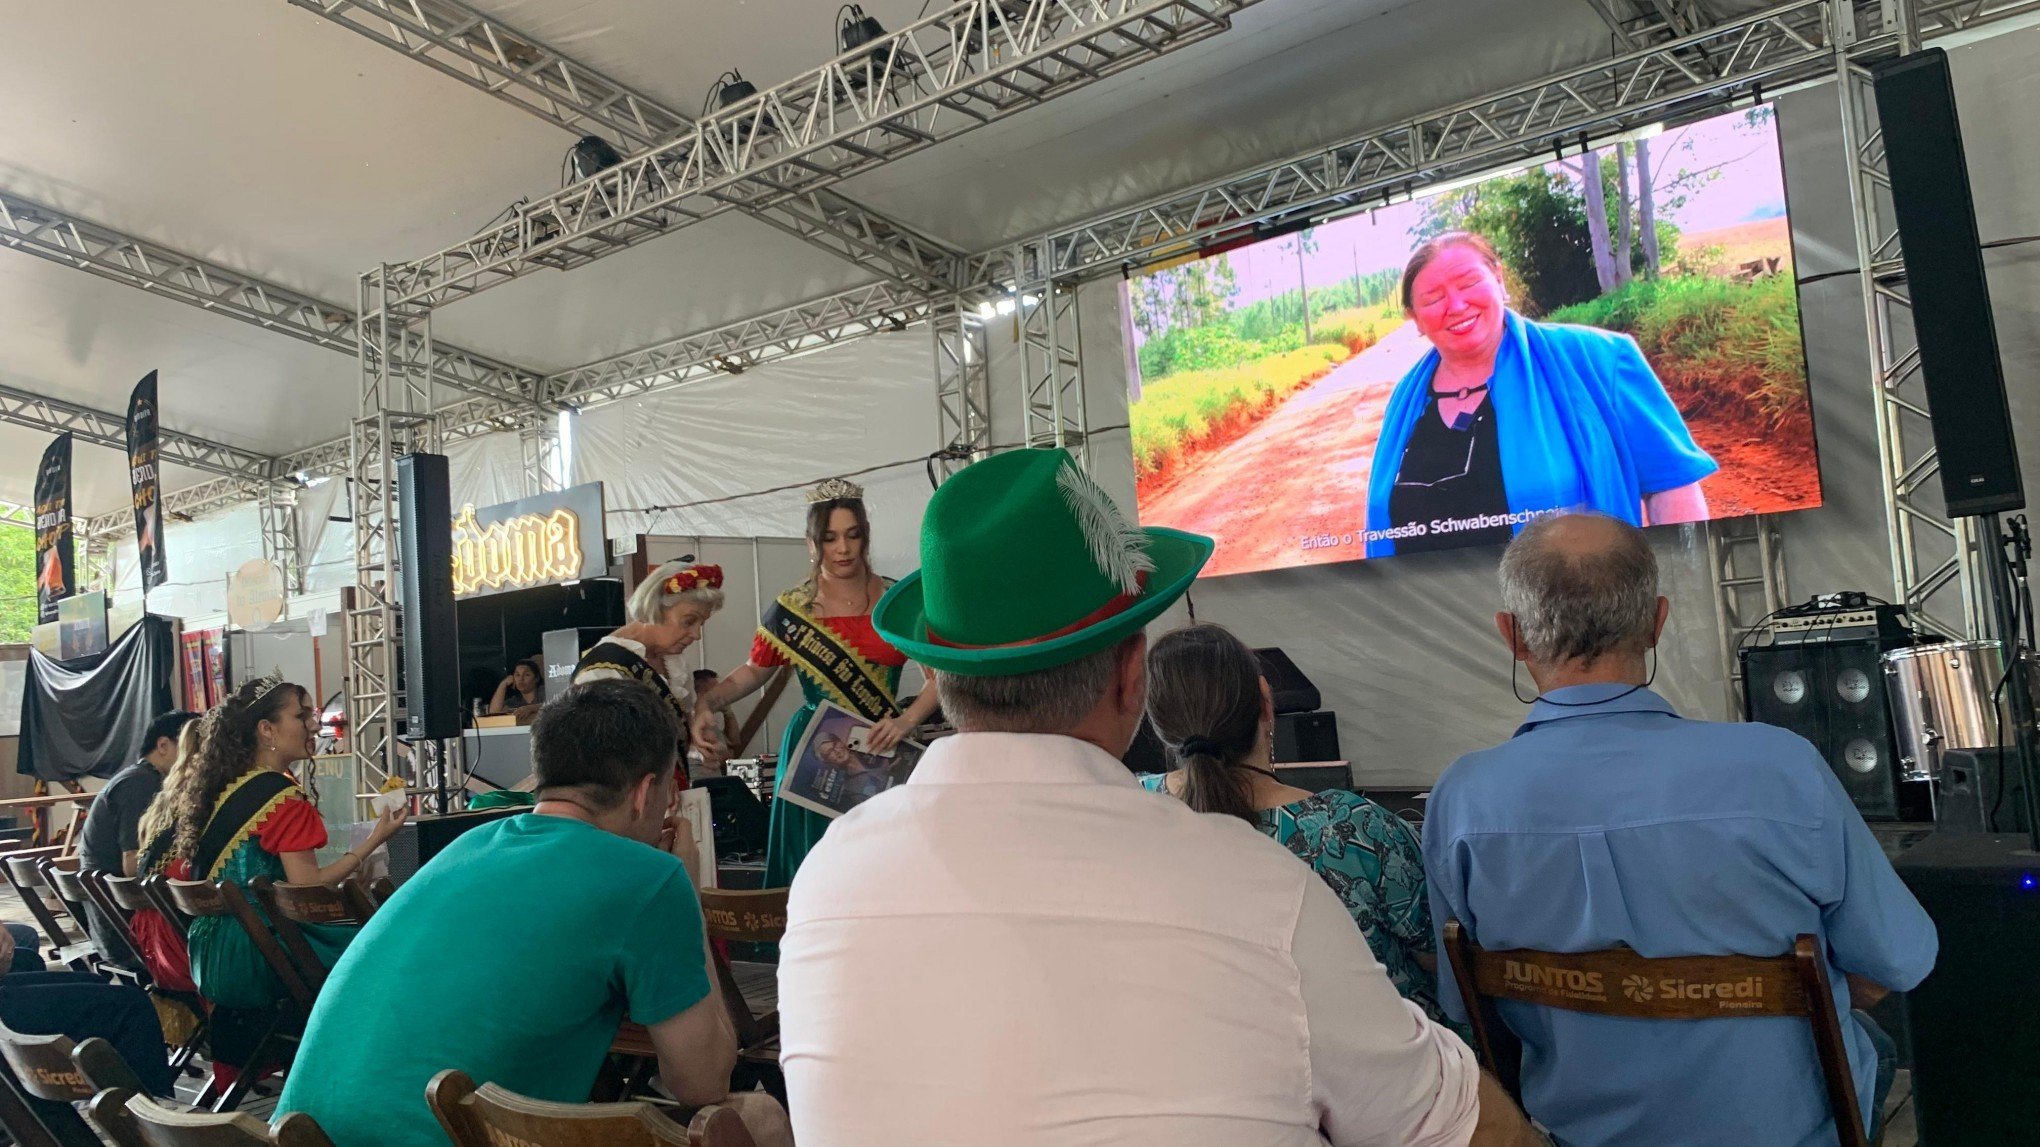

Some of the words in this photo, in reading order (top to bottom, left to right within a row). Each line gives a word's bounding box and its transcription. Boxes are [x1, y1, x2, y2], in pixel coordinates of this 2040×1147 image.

[1300, 533, 1339, 549] Então
[1342, 534, 1353, 545] o
[1356, 521, 1428, 543] Travessão
[316, 760, 345, 779] ENU
[1503, 960, 1605, 993] JUNTOS
[1659, 976, 1763, 999] Sicredi
[1719, 1001, 1763, 1009] Pioneira
[36, 1068, 88, 1086] Sicred
